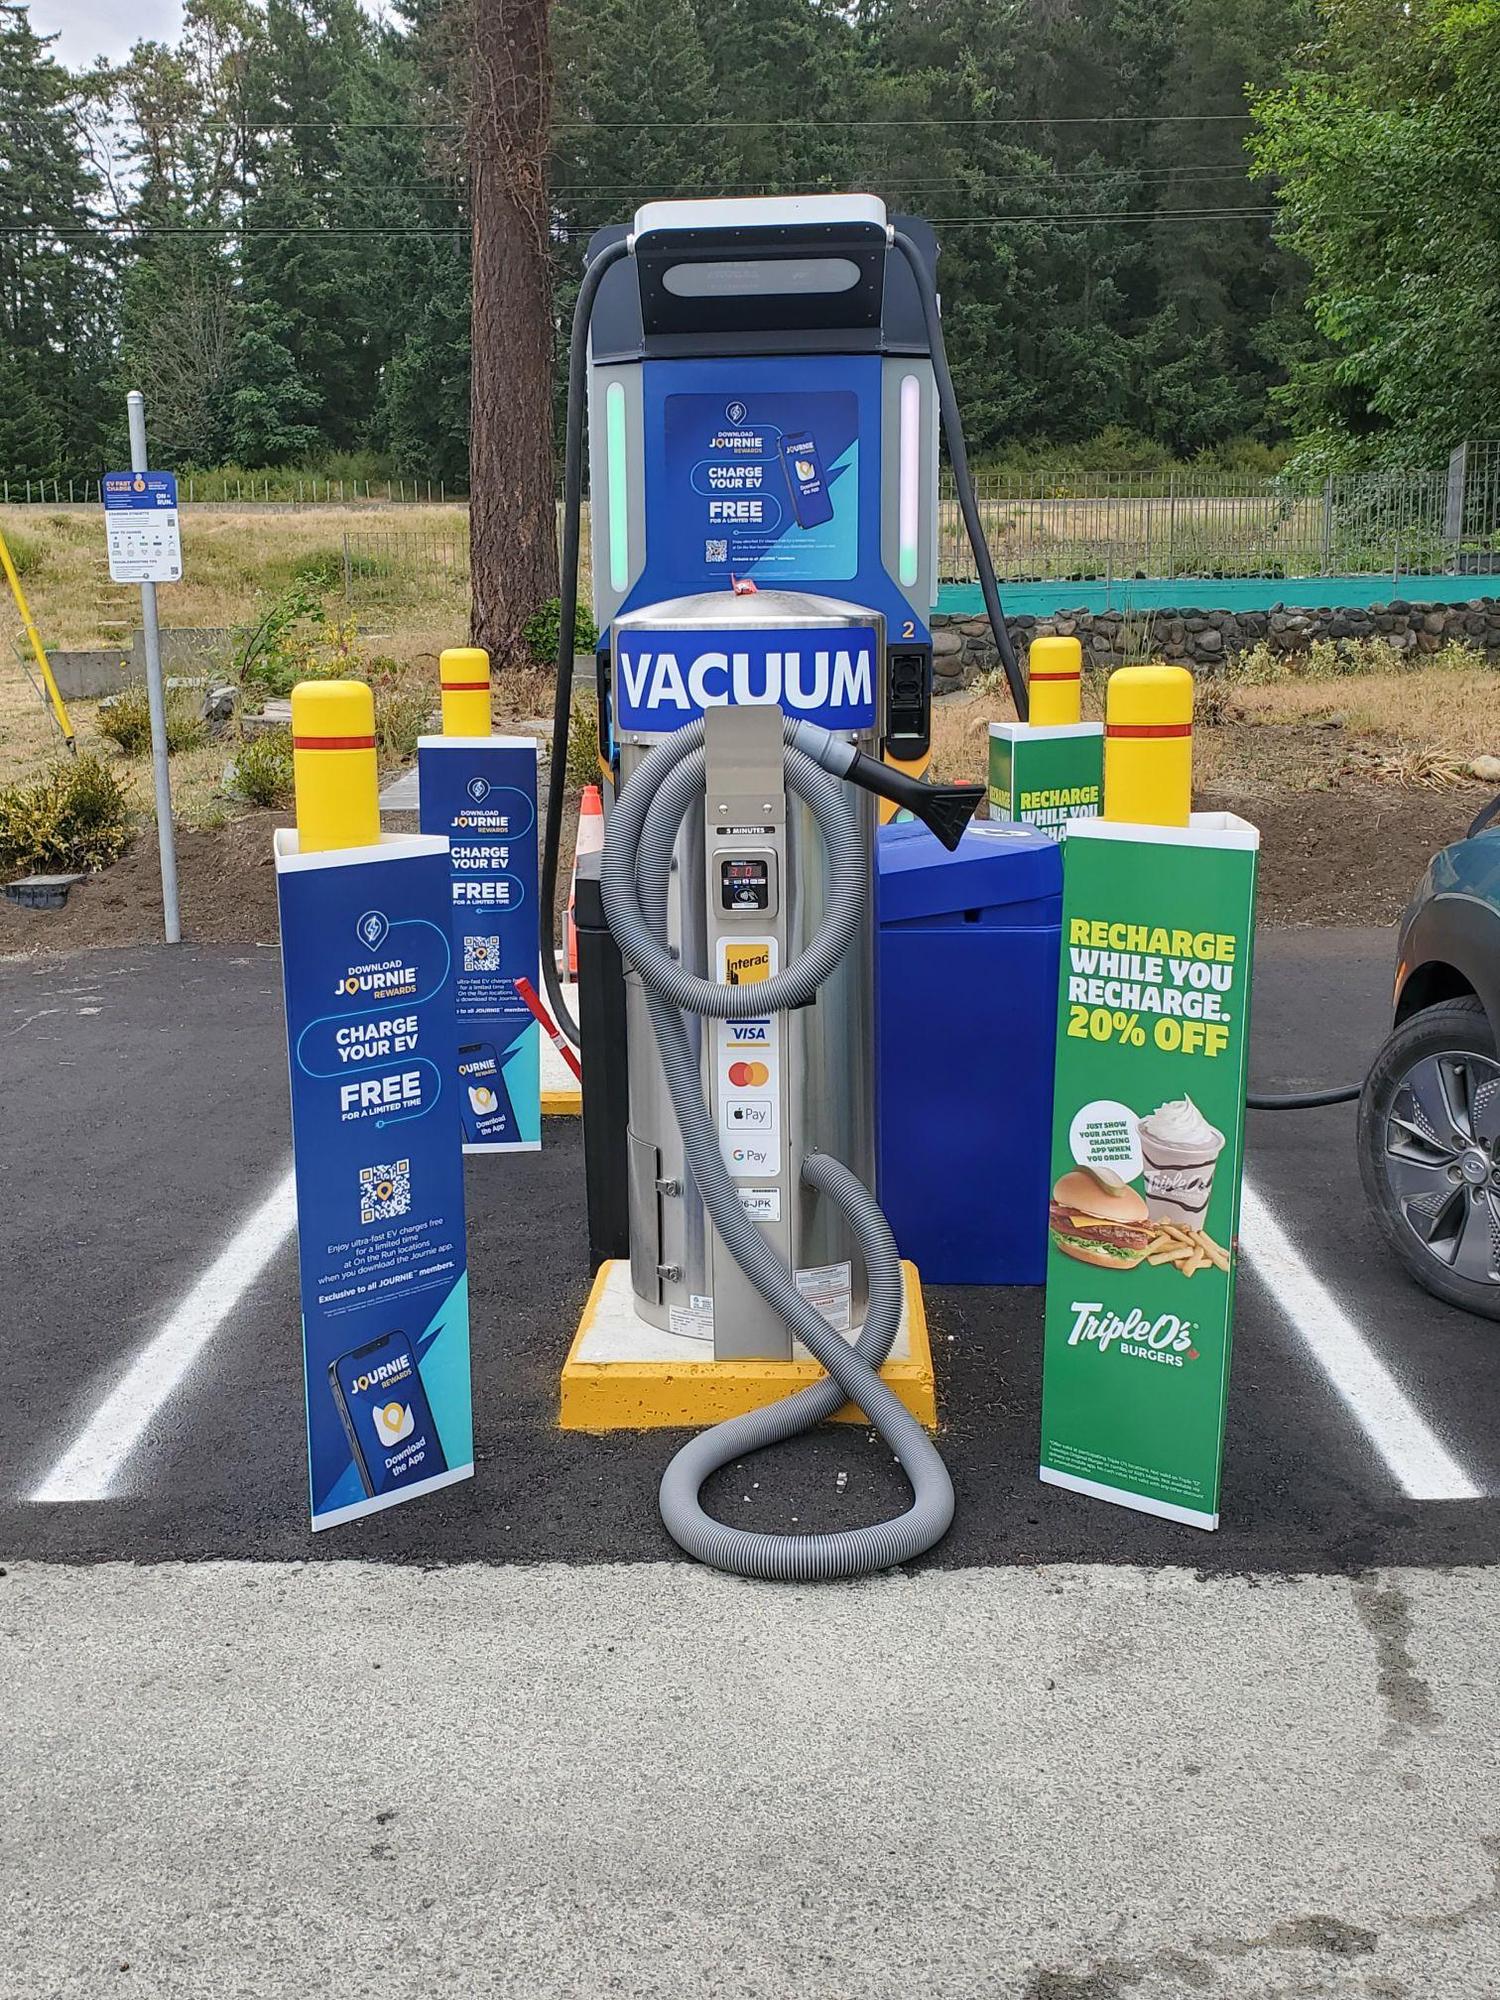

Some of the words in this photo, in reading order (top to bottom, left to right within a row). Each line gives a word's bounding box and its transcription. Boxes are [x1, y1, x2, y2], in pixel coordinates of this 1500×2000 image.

[709, 438, 762, 448] JOURNIE
[708, 466, 762, 478] CHARGE
[709, 478, 744, 488] YOUR
[746, 478, 762, 488] EV
[709, 502, 762, 518] FREE
[902, 622, 915, 638] 2
[620, 650, 872, 710] VACUUM
[1020, 786, 1098, 810] RECHARGE
[451, 816, 509, 828] JOURNIE
[1020, 806, 1068, 826] WHILE
[1070, 804, 1098, 818] YOU
[450, 847, 509, 858] CHARGE
[452, 858, 488, 869] YOUR
[492, 858, 509, 868] EV
[452, 882, 510, 899] FREE
[1069, 918, 1236, 962] RECHARGE
[348, 960, 402, 976] DOWNLOAD
[726, 954, 769, 972] Interac
[1069, 948, 1163, 984] WHILE
[1169, 958, 1233, 992] YOU
[334, 967, 416, 996] JOURNIE
[374, 984, 416, 1000] REWARDS
[1068, 976, 1232, 1022] RECHARGE.
[336, 1015, 419, 1046] CHARGE
[732, 1028, 766, 1040] VISA
[1066, 1005, 1146, 1048] 20%
[1154, 1017, 1230, 1058] OFF
[338, 1042, 390, 1064] YOUR
[394, 1034, 419, 1052] EV
[458, 1059, 496, 1076] OURNIE
[340, 1071, 422, 1112] FREE
[342, 1111, 360, 1122] FOR
[360, 1109, 368, 1118] A
[369, 1102, 402, 1116] LIMITED
[402, 1098, 422, 1110] TIME
[746, 1108, 766, 1124] Pay
[476, 1114, 506, 1129] Download
[481, 1126, 492, 1136] the
[492, 1123, 505, 1134] App
[1086, 1122, 1102, 1130] JUST
[1090, 1137, 1130, 1146] CHARGING
[746, 1150, 767, 1163] Pay
[741, 1200, 772, 1208] 6-JPK
[328, 1242, 350, 1254] Enjoy
[351, 1233, 386, 1248] ultra-fast
[386, 1229, 398, 1239] EV
[400, 1222, 428, 1235] charges
[429, 1218, 444, 1227] free
[356, 1248, 366, 1256] for
[375, 1238, 400, 1251] limited
[402, 1234, 418, 1244] time
[318, 1274, 340, 1285] when
[341, 1270, 356, 1280] you
[358, 1260, 396, 1276] download
[396, 1254, 410, 1264] the
[410, 1247, 437, 1260] Journie
[438, 1243, 454, 1253] app.
[344, 1261, 352, 1269] at
[353, 1258, 366, 1266] On
[366, 1254, 380, 1263] the
[381, 1250, 396, 1259] Run
[398, 1240, 430, 1254] locations
[318, 1288, 356, 1304] Exclusive
[357, 1286, 366, 1294] to
[367, 1282, 377, 1292] all
[419, 1260, 455, 1276] members.
[1120, 1342, 1184, 1368] BURGERS
[351, 1354, 410, 1394] JOURNIE
[382, 1368, 412, 1390] REWARDS
[384, 1436, 426, 1469] Download
[392, 1463, 407, 1477] the
[408, 1450, 426, 1466] App
